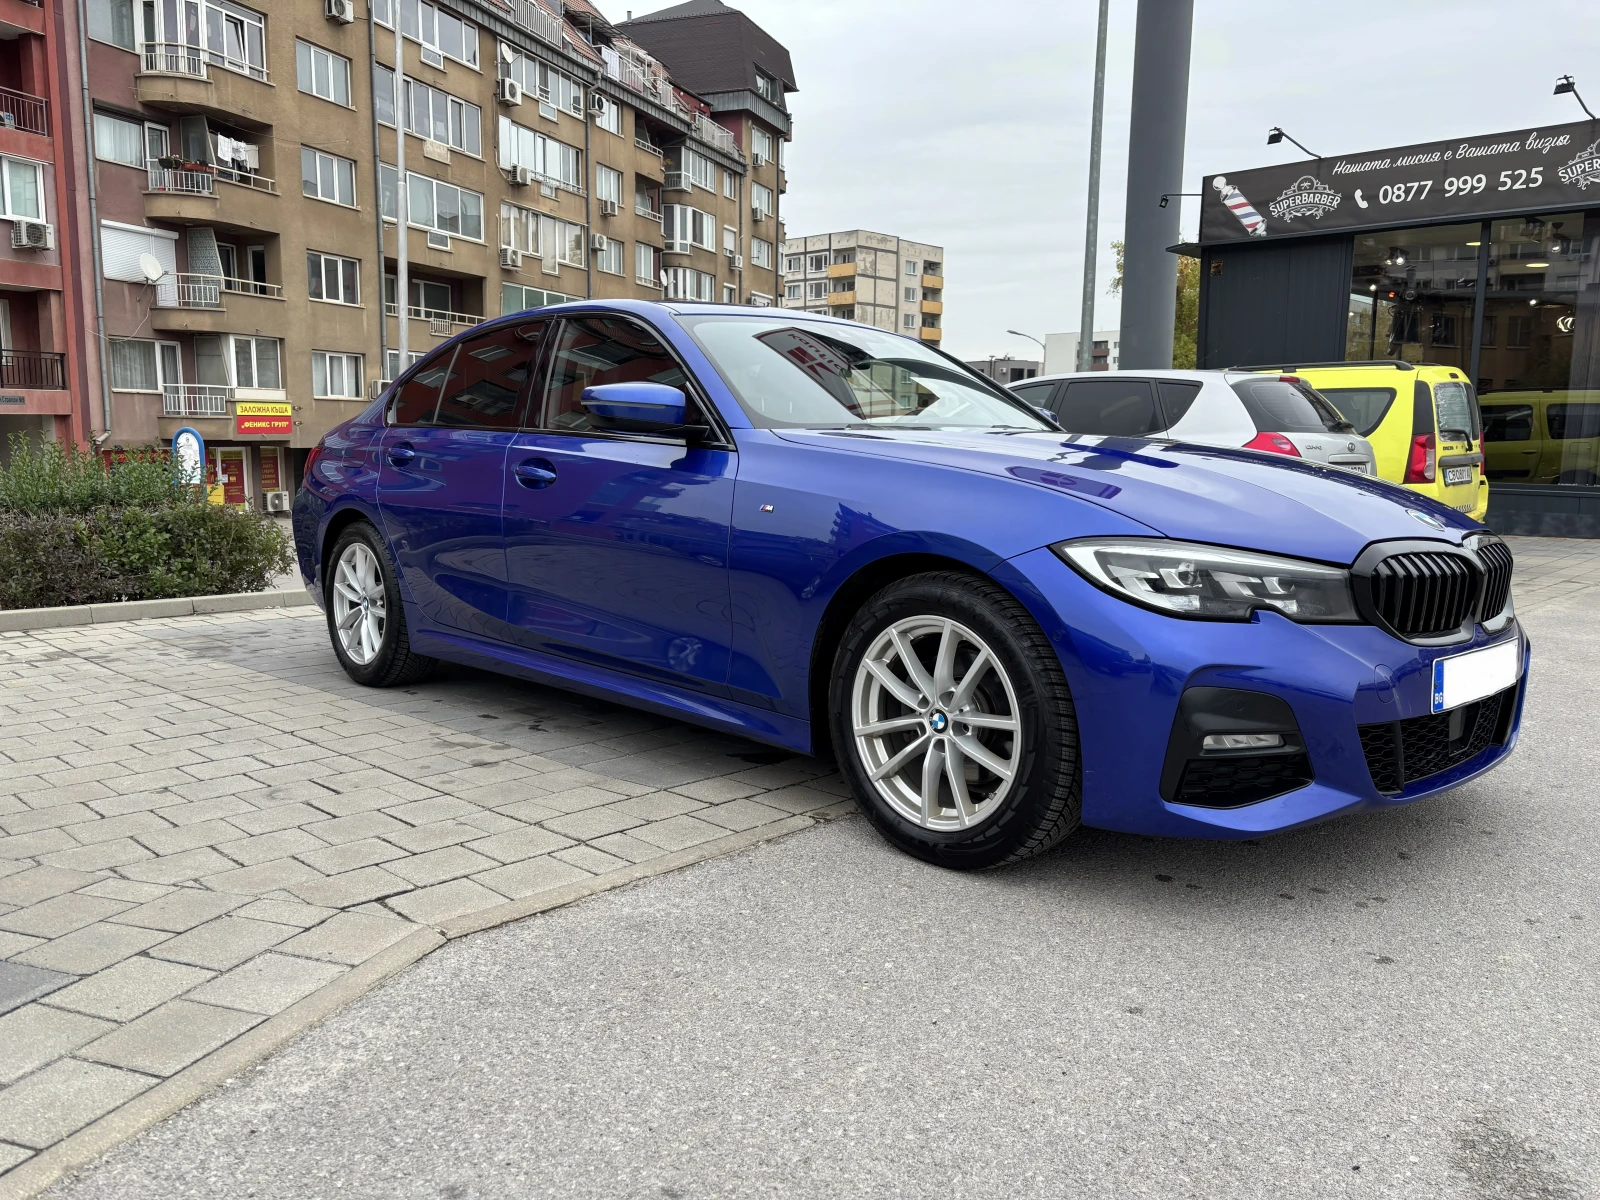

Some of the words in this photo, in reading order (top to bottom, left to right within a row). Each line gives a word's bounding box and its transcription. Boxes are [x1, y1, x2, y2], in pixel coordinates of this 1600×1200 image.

[1332, 158, 1391, 175] Нашата
[1393, 151, 1441, 168] мисия
[1444, 150, 1453, 160] е
[1456, 141, 1521, 159] Вашата
[1525, 131, 1571, 154] визия
[1379, 180, 1433, 205] 0877
[1444, 173, 1487, 198] 999
[1497, 166, 1544, 191] 525
[1269, 193, 1341, 216] SUPERBARBER
[240, 405, 270, 414] ЗАЛОЖНА
[271, 406, 289, 414] КЪЩА
[1434, 692, 1443, 704] BG
